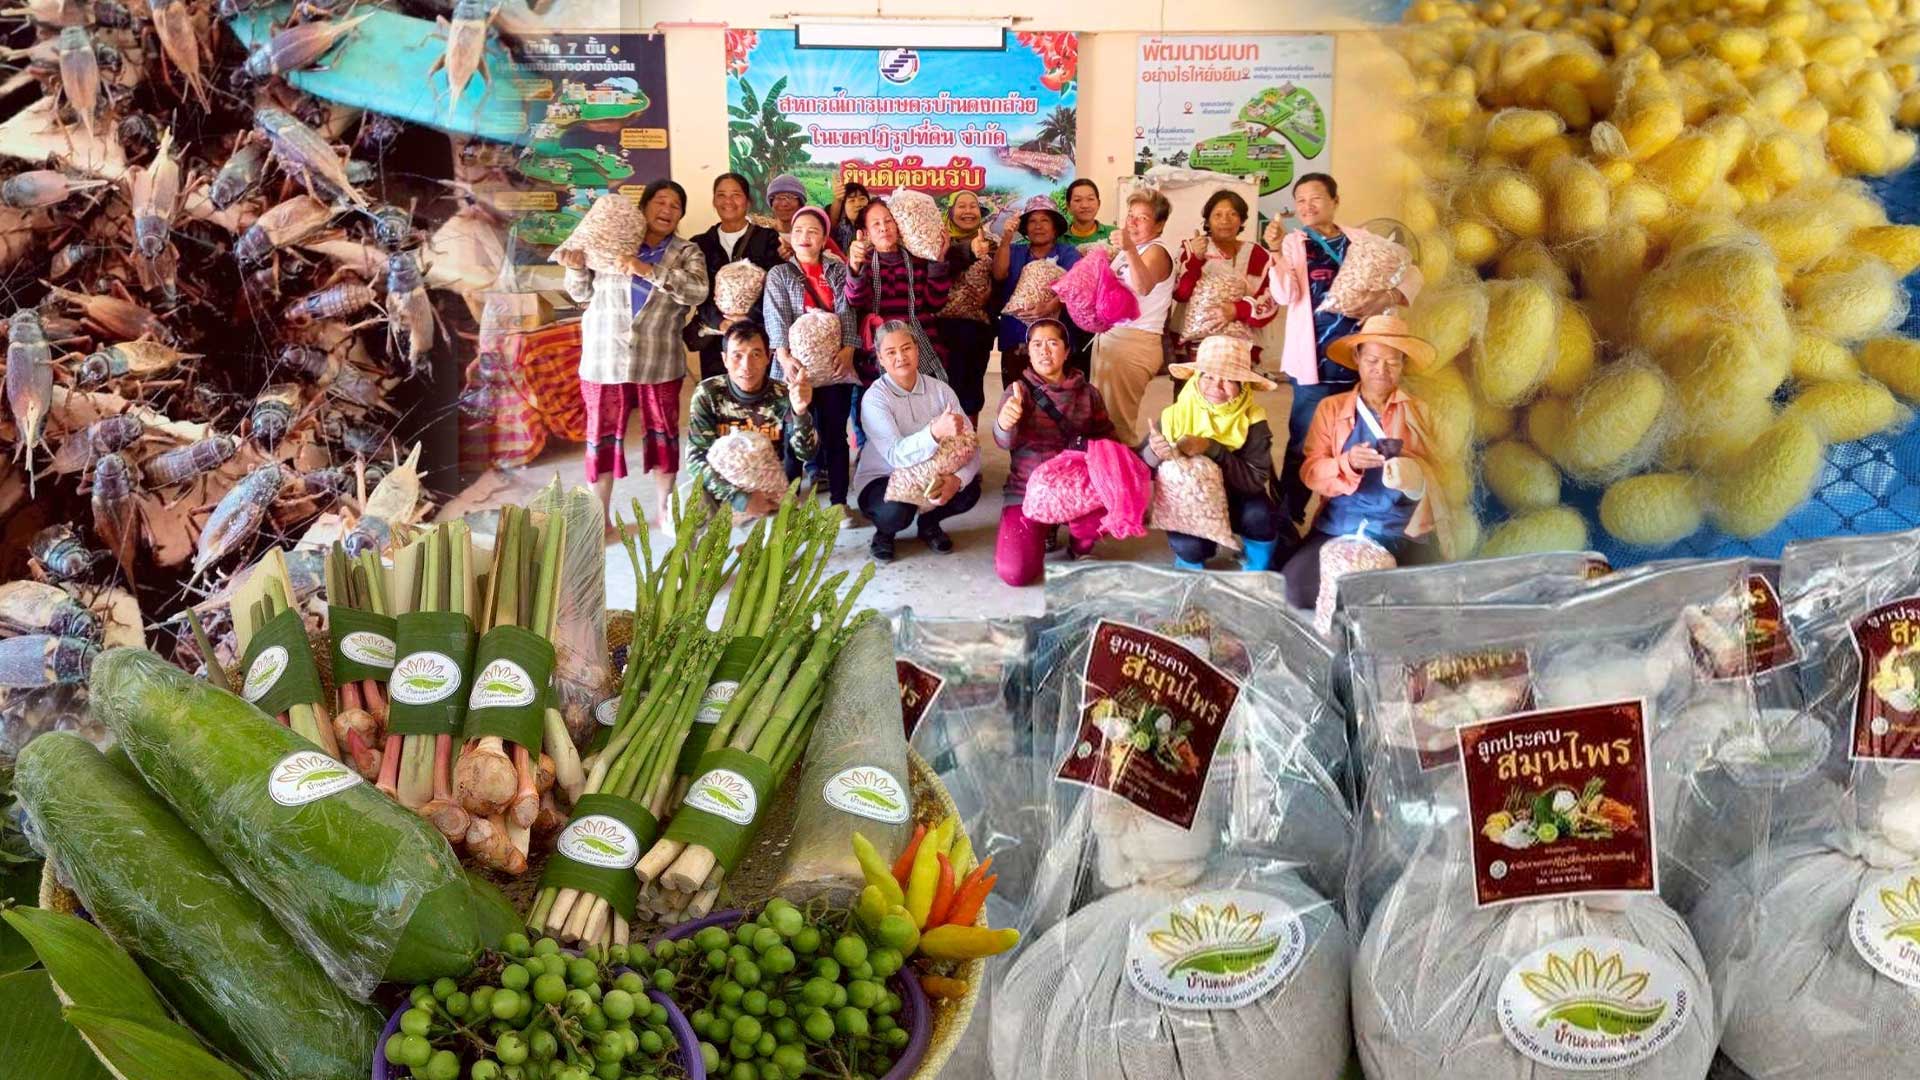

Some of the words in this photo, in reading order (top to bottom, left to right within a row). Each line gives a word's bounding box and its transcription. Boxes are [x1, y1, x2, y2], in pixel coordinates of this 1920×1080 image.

[568, 43, 577, 54] 7
[585, 37, 606, 54] ขั้น
[1143, 40, 1259, 61] พัฒนาชนบท
[1142, 65, 1243, 83] อย่างไรให้ยั่งยืน
[778, 91, 1037, 114] สหกรณ์การเกษตรบ้านดงกล้วย
[809, 121, 955, 152] ในเขตปฏิรูปที่ดิน
[960, 124, 1007, 147] จำกัด
[843, 157, 981, 187] ยินดีต้อนรับ
[1110, 635, 1188, 677] ลูกประคบ
[1121, 656, 1220, 726] สมุนไพร
[1478, 728, 1561, 763] ลูกประคบ
[1498, 731, 1632, 787] สมุนไพร
